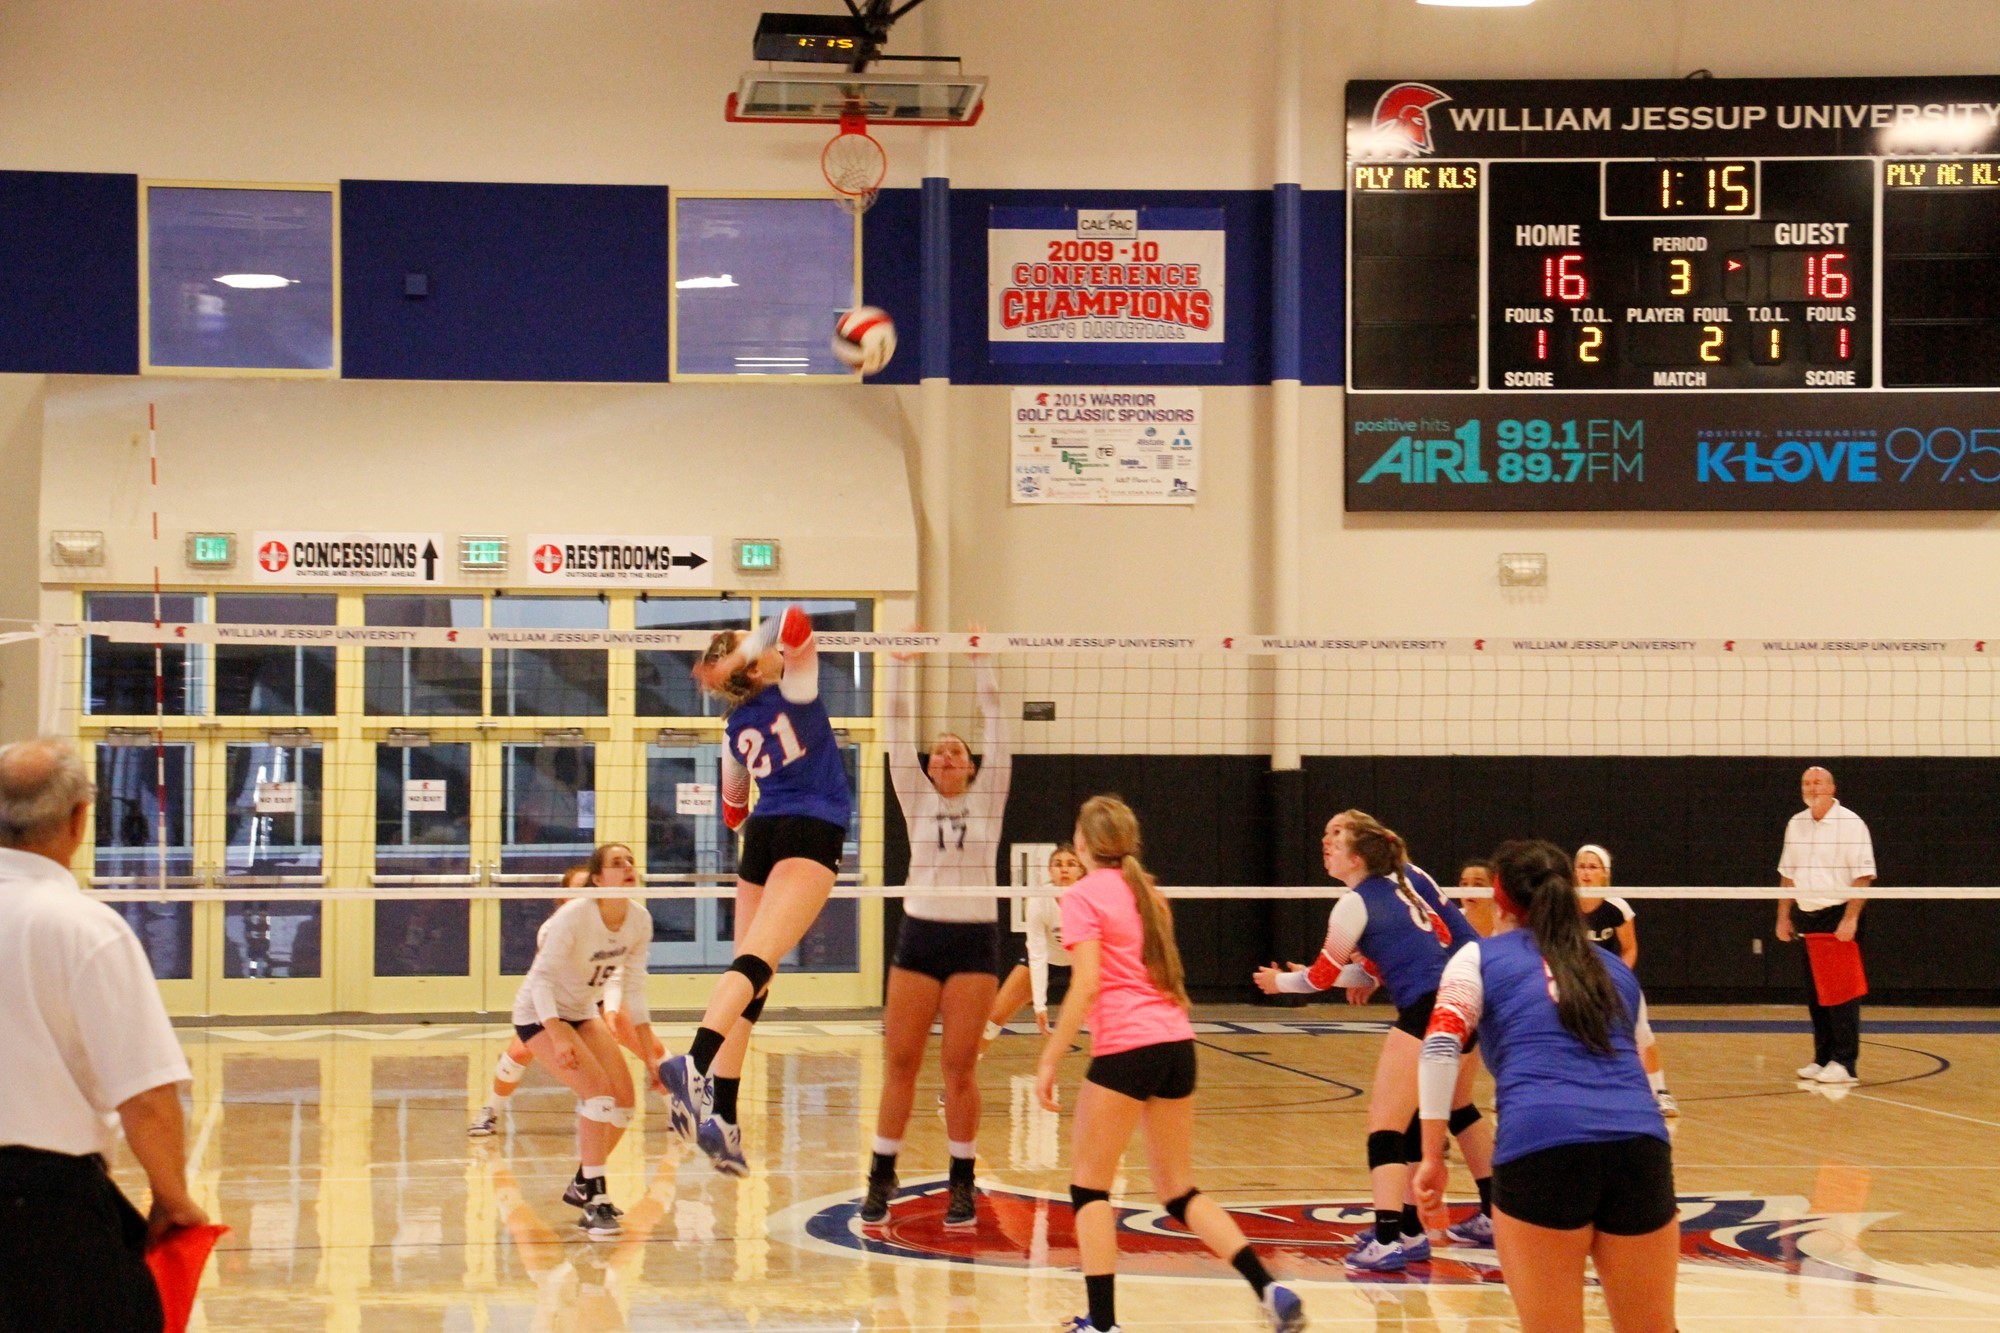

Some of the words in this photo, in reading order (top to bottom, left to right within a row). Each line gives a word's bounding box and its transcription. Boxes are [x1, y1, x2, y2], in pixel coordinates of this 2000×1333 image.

[1449, 107, 1611, 131] WILLIAM
[1621, 106, 1767, 130] JESSUP
[1355, 167, 1394, 189] PLY
[1404, 167, 1430, 188] AC
[1439, 167, 1477, 188] KLS
[1886, 164, 1926, 185] PLY
[1937, 163, 1964, 185] AC
[1972, 163, 2000, 185] KL
[1662, 165, 1748, 211] 1:15
[1081, 219, 1105, 230] CAL
[1109, 219, 1133, 230] PAC
[1774, 223, 1849, 245] GUEST
[1516, 225, 1581, 246] HOME
[1653, 236, 1708, 251] PERIOD
[1012, 263, 1201, 287] CONFERENCE
[1544, 255, 1586, 300] 16
[1670, 259, 1691, 294] 3
[1807, 253, 1848, 299] 16
[1001, 287, 1214, 331] CHAMPIONS
[1505, 308, 1554, 323] FOULS
[1570, 308, 1612, 323] T.O.L.
[1626, 307, 1685, 323] PLAYER
[1693, 307, 1733, 322] FOUL
[1747, 307, 1790, 322] T.O.L.
[1806, 306, 1856, 322] FOULS
[1537, 329, 1547, 360] 1
[1579, 326, 1603, 362] 2
[1700, 326, 1724, 362] 2
[1770, 328, 1780, 359] 1
[1839, 328, 1849, 359] 1
[1504, 371, 1554, 387] SCORE
[1653, 371, 1707, 387] MATCH
[1805, 371, 1856, 386] SCORE
[1053, 393, 1087, 407] 2015
[1090, 393, 1155, 407] WARRIOR
[1017, 408, 1052, 422] GOLF
[1056, 408, 1115, 422] CLASSIC
[1119, 409, 1194, 422] SPONSORS
[1355, 418, 1417, 435] positive
[1420, 418, 1450, 432] hits
[1497, 419, 1581, 450] 99.1
[1588, 419, 1644, 449] FM
[1885, 427, 2000, 483] 99.5
[1497, 452, 1586, 483] 89.7
[1588, 453, 1644, 482] FM
[293, 542, 417, 568] CONCESSIONS
[565, 545, 670, 570] RESTROOMS
[217, 628, 278, 638] WILLIAM
[280, 629, 333, 639] JESSUP
[336, 630, 418, 640] UNIVERSITY
[487, 632, 546, 643] WILLIAM
[549, 633, 600, 643] JESSUP
[603, 634, 682, 644] UNIVERSITY
[864, 636, 941, 646] UNIVERSITY
[1008, 637, 1064, 647] WILLIAM
[1067, 638, 1114, 648] JESSUP
[1117, 638, 1196, 649] UNIVERSITY
[1261, 639, 1317, 649] WILLIAM
[1320, 639, 1369, 649] JESSUP
[1371, 640, 1448, 650] UNIVERSITY
[1513, 640, 1568, 650] WILLIAM
[1570, 640, 1619, 650] JESSUP
[1621, 640, 1697, 650] UNIVERSITY
[1763, 641, 1818, 651] WILLIAM
[1820, 641, 1869, 651] JESSUP
[1872, 641, 1948, 651] UNIVERSITY
[737, 712, 806, 778] 21
